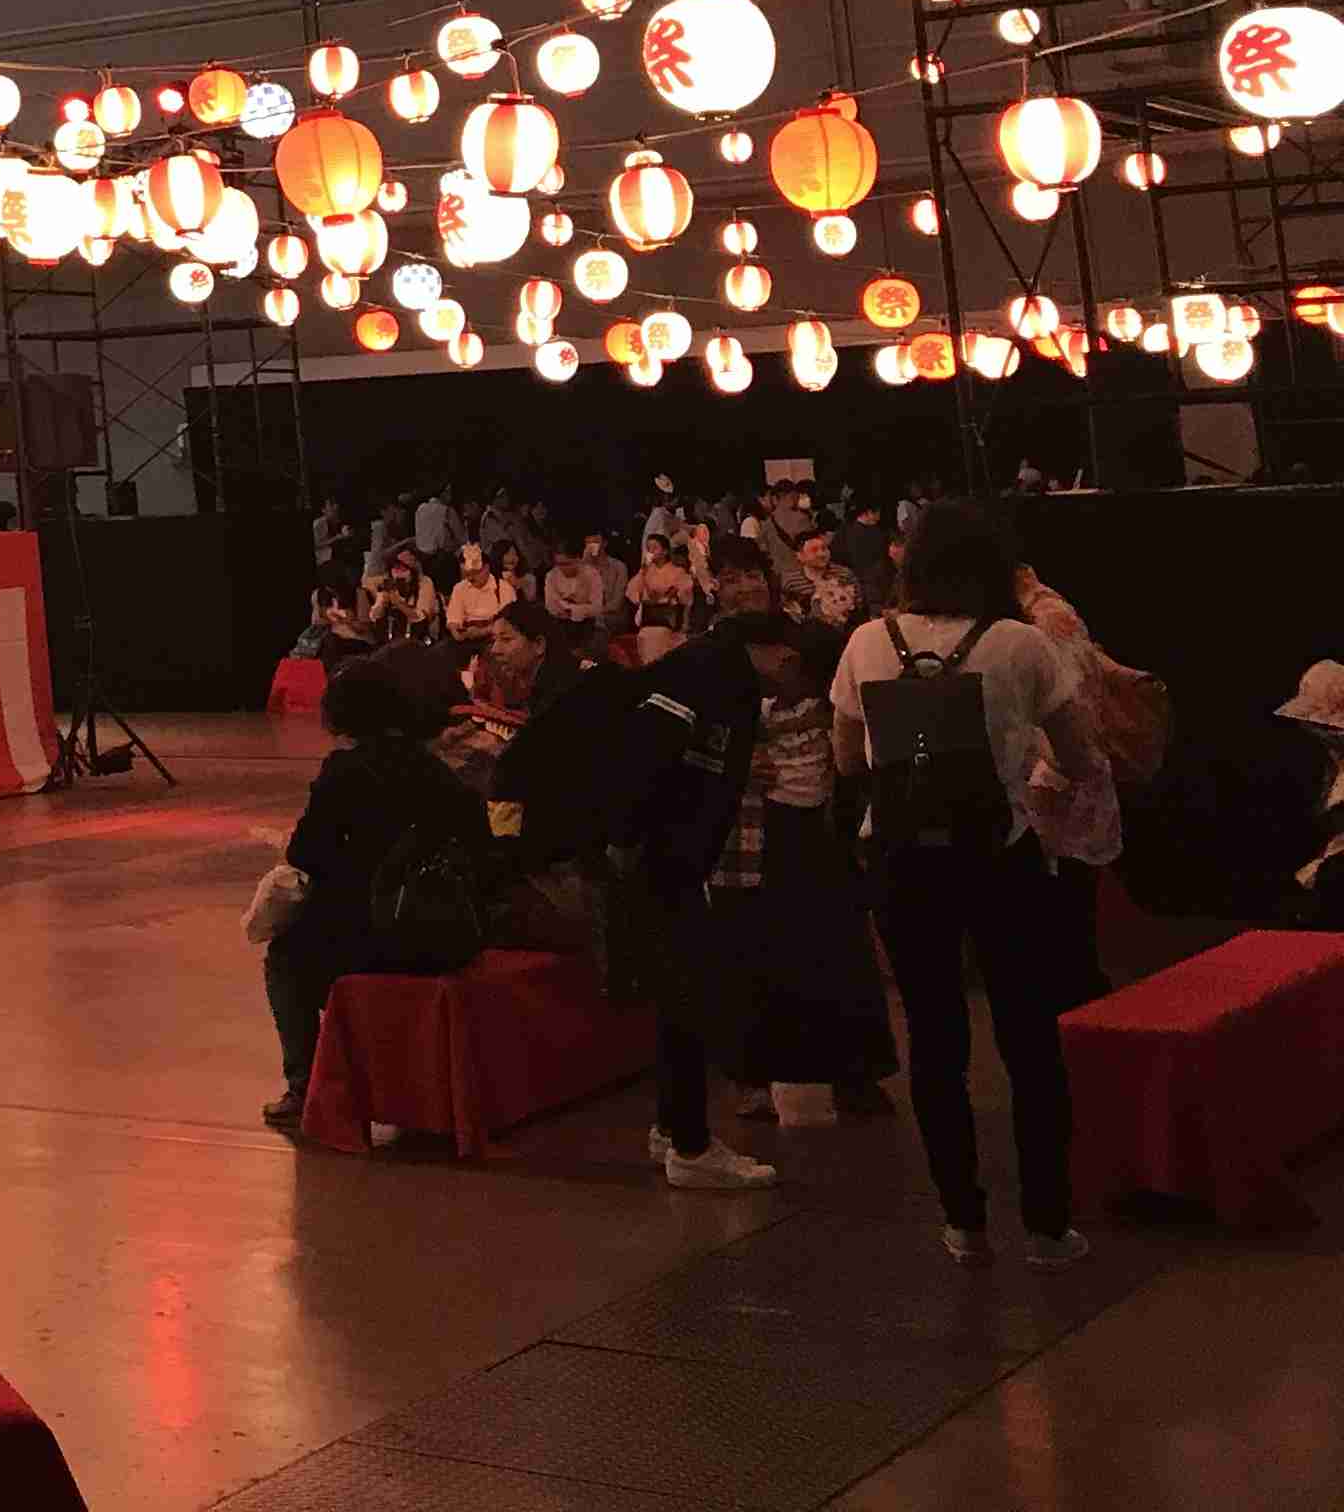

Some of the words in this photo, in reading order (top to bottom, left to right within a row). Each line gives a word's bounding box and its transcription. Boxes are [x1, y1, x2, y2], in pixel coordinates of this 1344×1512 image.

[644, 17, 693, 93] 祭
[1227, 24, 1297, 99] 祭
[877, 288, 911, 318] 祭
